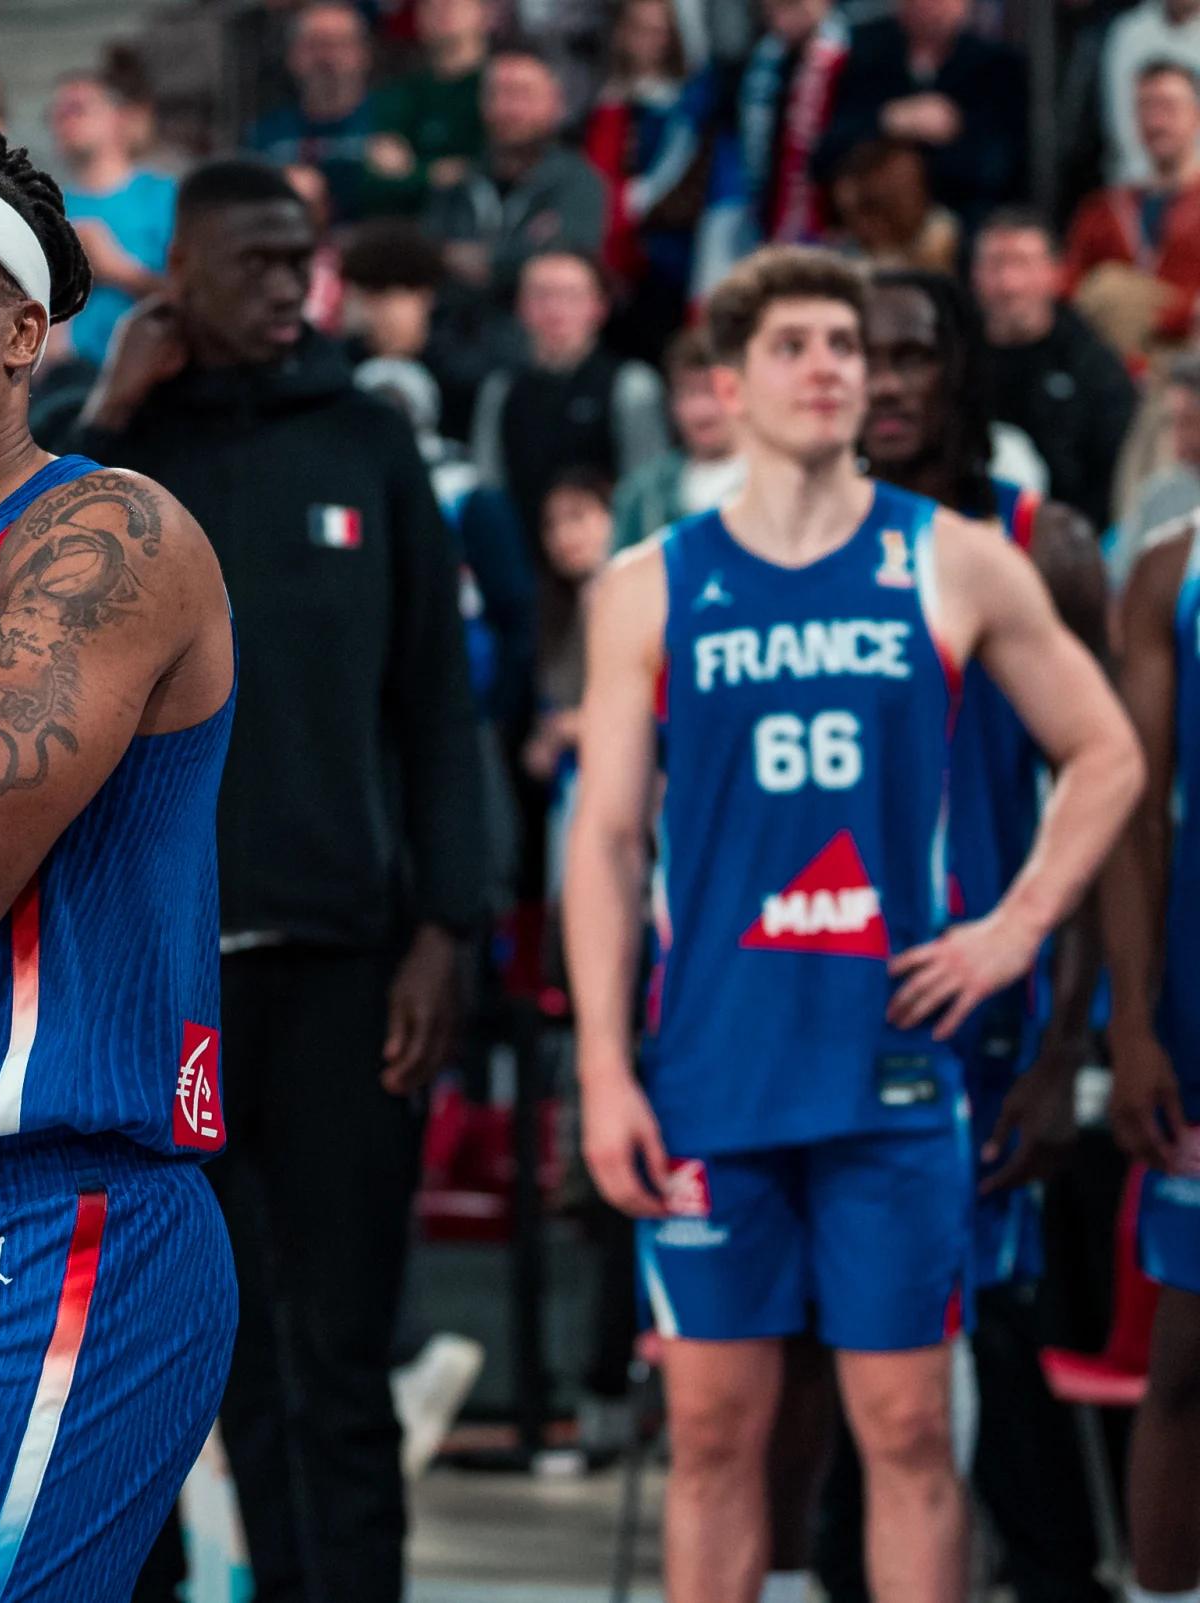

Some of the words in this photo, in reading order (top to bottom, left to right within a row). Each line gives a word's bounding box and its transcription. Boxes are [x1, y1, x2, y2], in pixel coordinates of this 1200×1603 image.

[695, 618, 911, 692] FRANCE
[754, 711, 862, 793] 66
[762, 886, 881, 937] MAIF
